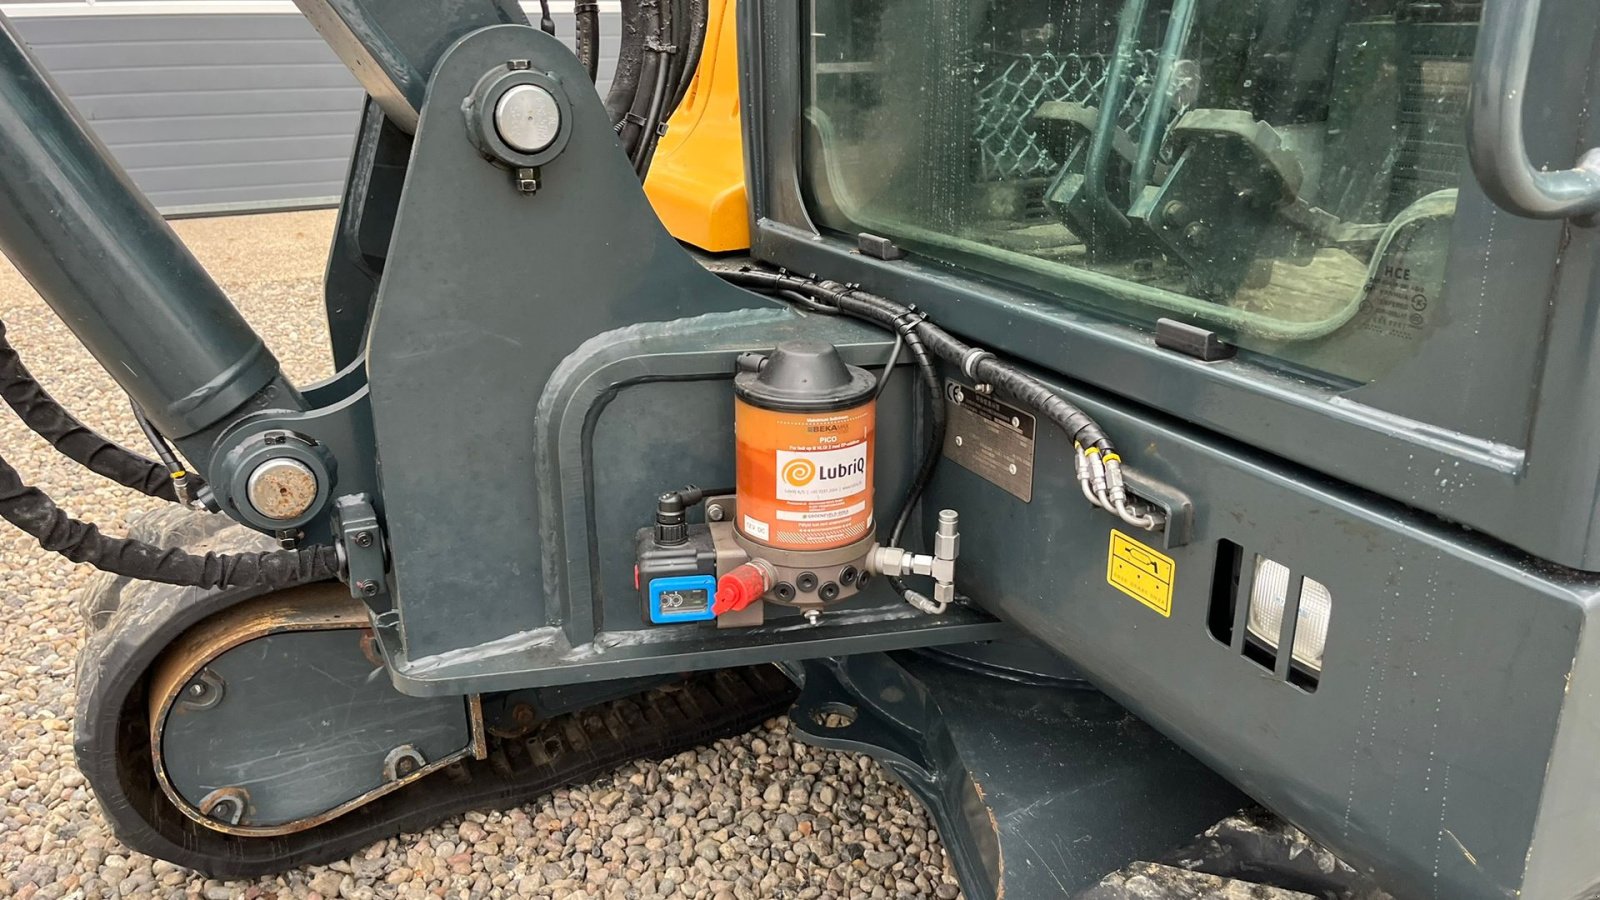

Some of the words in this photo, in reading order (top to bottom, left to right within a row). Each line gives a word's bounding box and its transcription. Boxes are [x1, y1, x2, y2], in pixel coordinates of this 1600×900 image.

[1384, 265, 1411, 280] HCE
[819, 435, 837, 444] PICO
[819, 457, 864, 480] LubriQ
